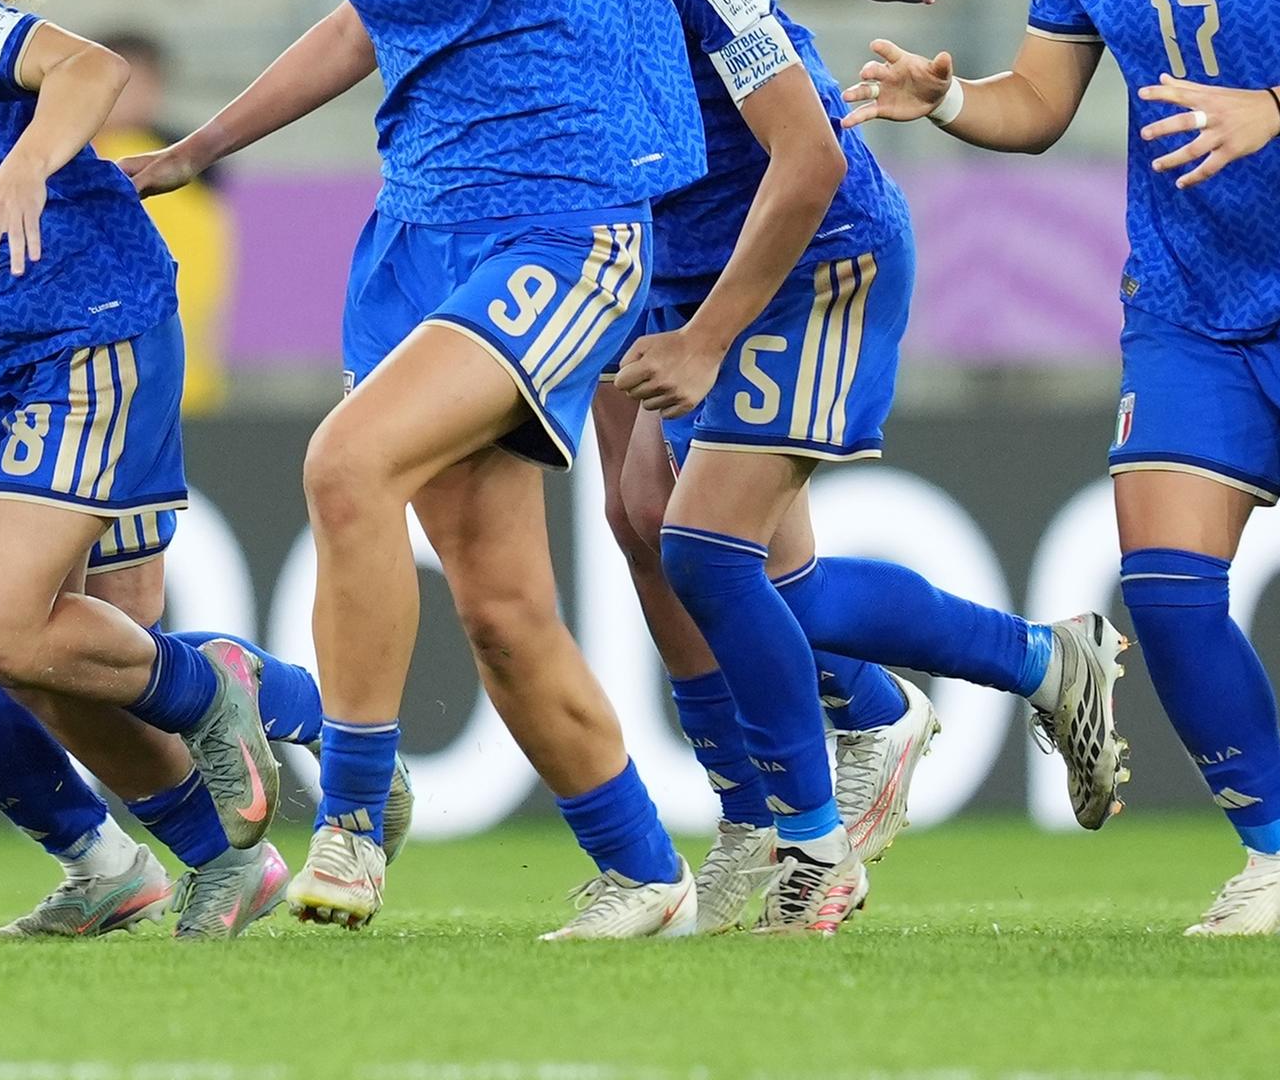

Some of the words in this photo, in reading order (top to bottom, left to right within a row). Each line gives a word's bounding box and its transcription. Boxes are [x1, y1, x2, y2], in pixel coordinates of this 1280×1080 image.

[719, 27, 769, 60] FOOTBALL
[725, 36, 779, 76] UNITES
[732, 74, 752, 91] the
[751, 48, 790, 80] World
[488, 264, 557, 337] 9
[734, 335, 788, 425] 5
